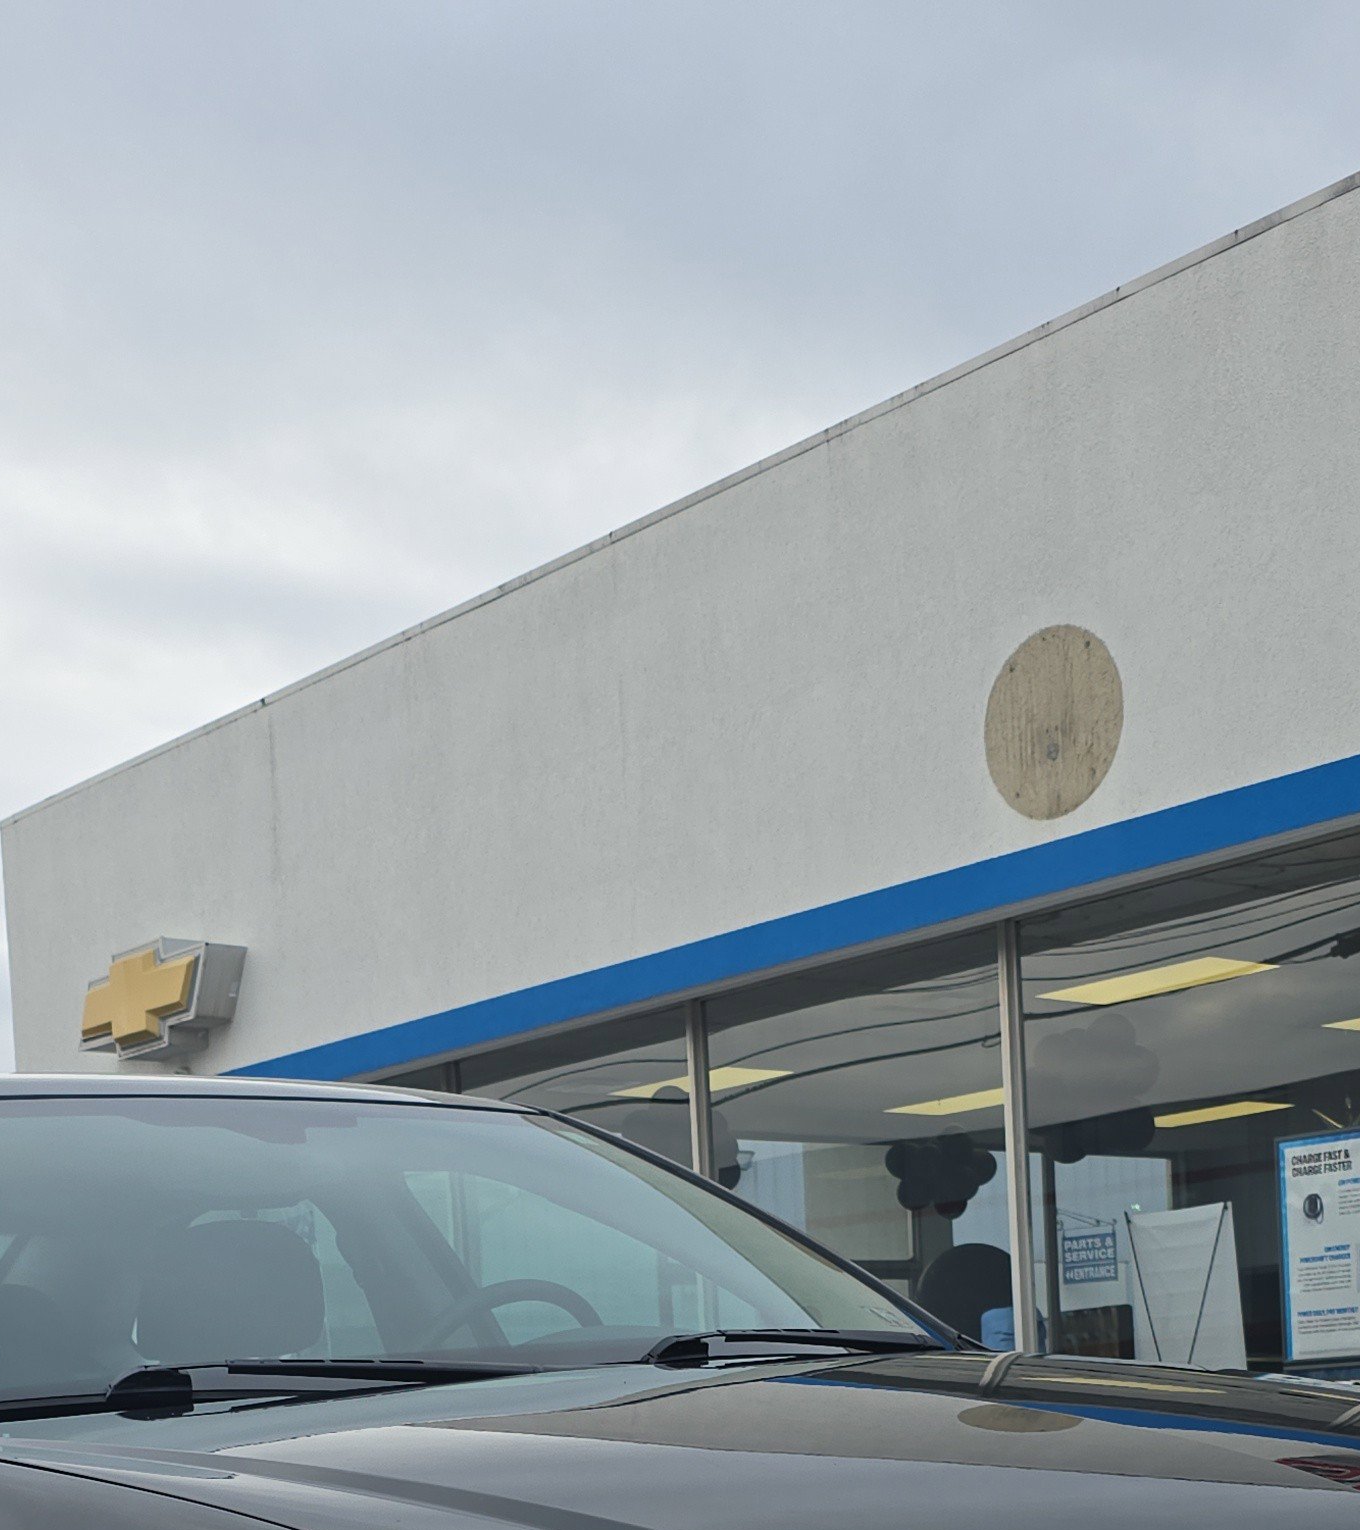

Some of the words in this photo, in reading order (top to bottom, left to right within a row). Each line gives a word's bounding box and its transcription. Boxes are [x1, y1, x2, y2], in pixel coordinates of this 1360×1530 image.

[1291, 1152, 1322, 1166] CHARGE
[1323, 1149, 1343, 1162] FAST
[1291, 1163, 1323, 1178] CHARGE
[1323, 1160, 1353, 1174] FASTER
[1064, 1237, 1102, 1252] PARTS
[1105, 1236, 1113, 1247] &
[1064, 1247, 1115, 1263] SERVICE
[1074, 1265, 1116, 1280] ENTRANCE
